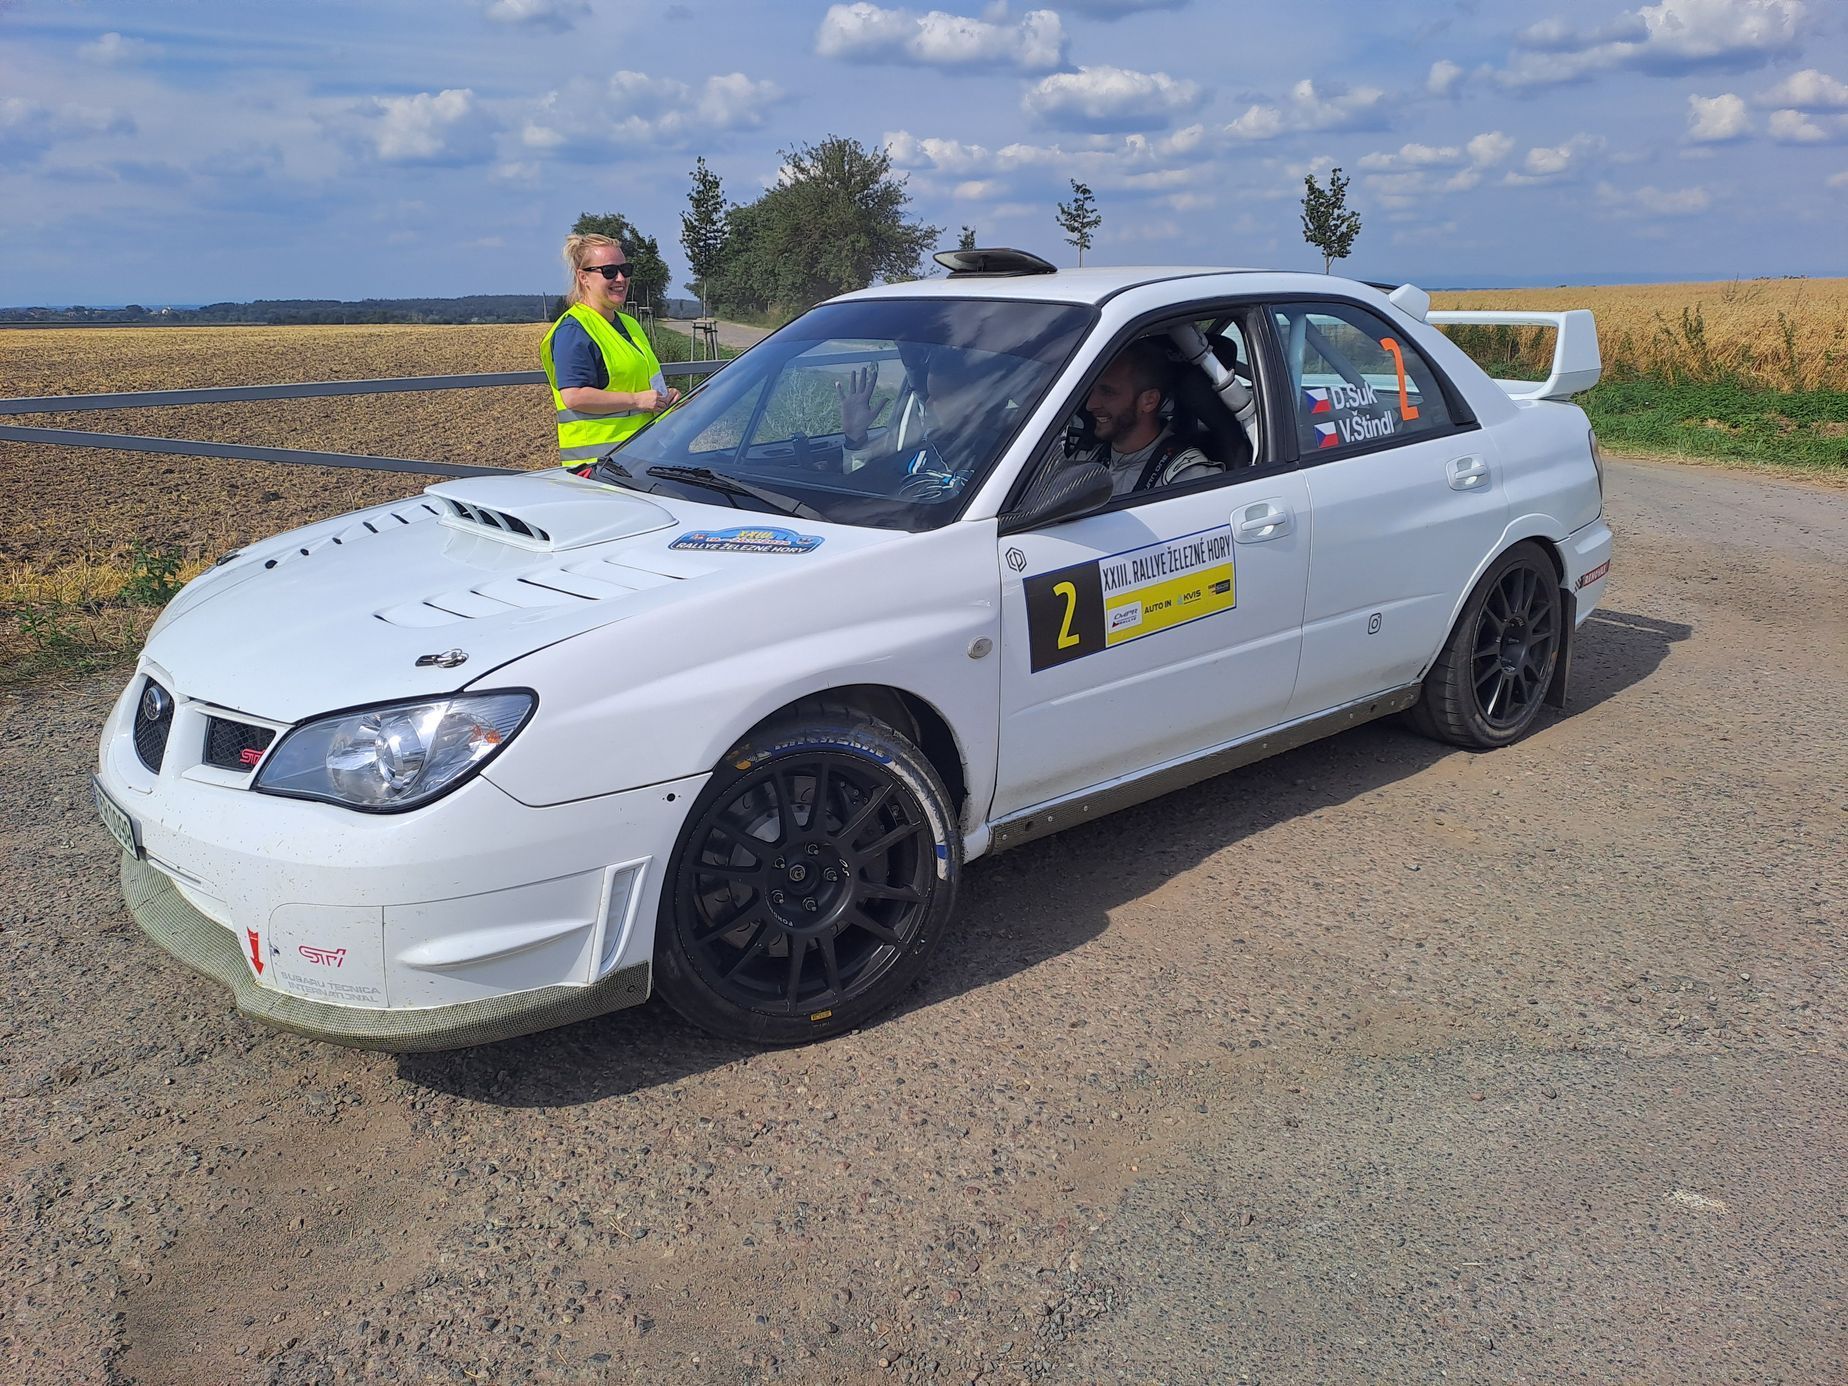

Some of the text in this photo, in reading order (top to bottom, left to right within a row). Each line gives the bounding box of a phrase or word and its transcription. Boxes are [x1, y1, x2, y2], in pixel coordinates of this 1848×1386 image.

[1379, 337, 1419, 421] 2
[1330, 381, 1378, 410] D.Suk
[1338, 409, 1395, 443] V.Štindl
[676, 542, 720, 550] RALLYE
[719, 541, 772, 551] ŽELEZNÉ
[771, 545, 808, 553] HORY
[1102, 534, 1231, 592] XXIII. RALLYE ŽELEZNÉ HORY
[1144, 600, 1172, 614] AUTO IN
[1183, 589, 1201, 601] KVIS
[1053, 581, 1080, 650] 2
[281, 971, 382, 995] SUBARU TECNICA
